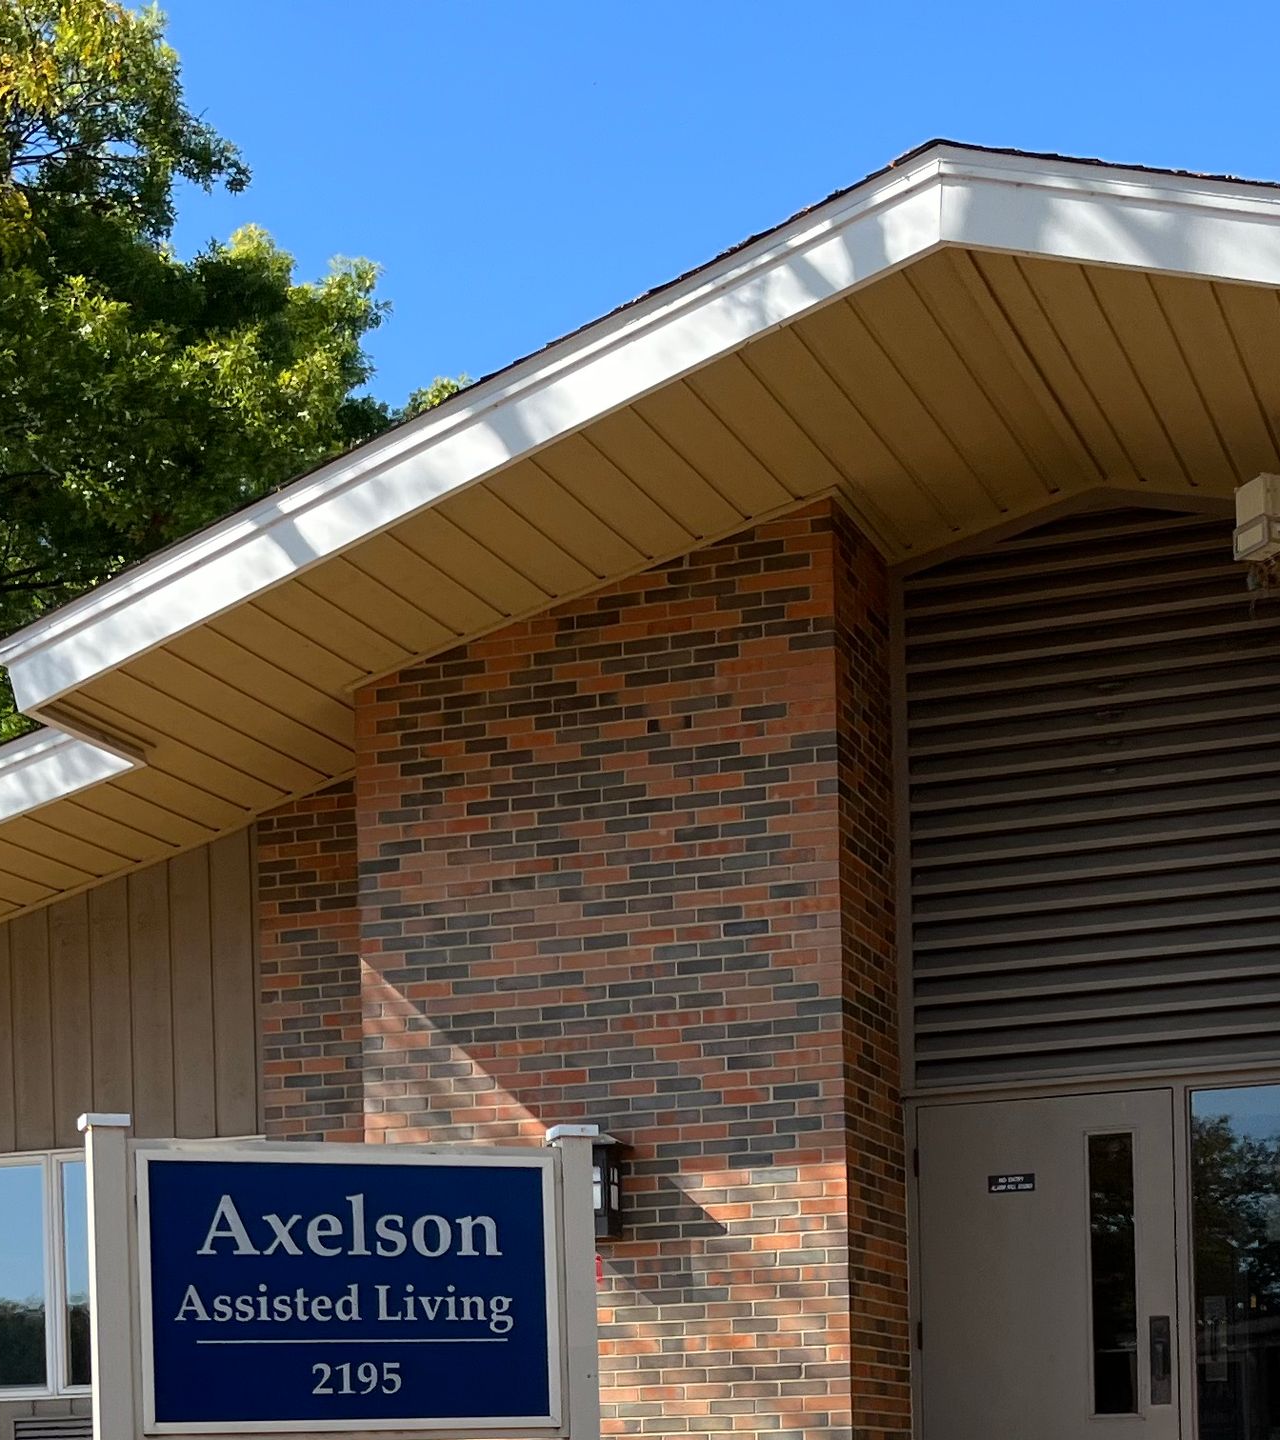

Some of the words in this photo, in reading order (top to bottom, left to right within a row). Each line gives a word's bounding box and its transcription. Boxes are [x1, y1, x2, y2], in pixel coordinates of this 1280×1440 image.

[197, 1193, 503, 1257] Axelson
[174, 1283, 363, 1322] Assisted
[376, 1284, 514, 1333] Living
[312, 1362, 402, 1395] 2195
